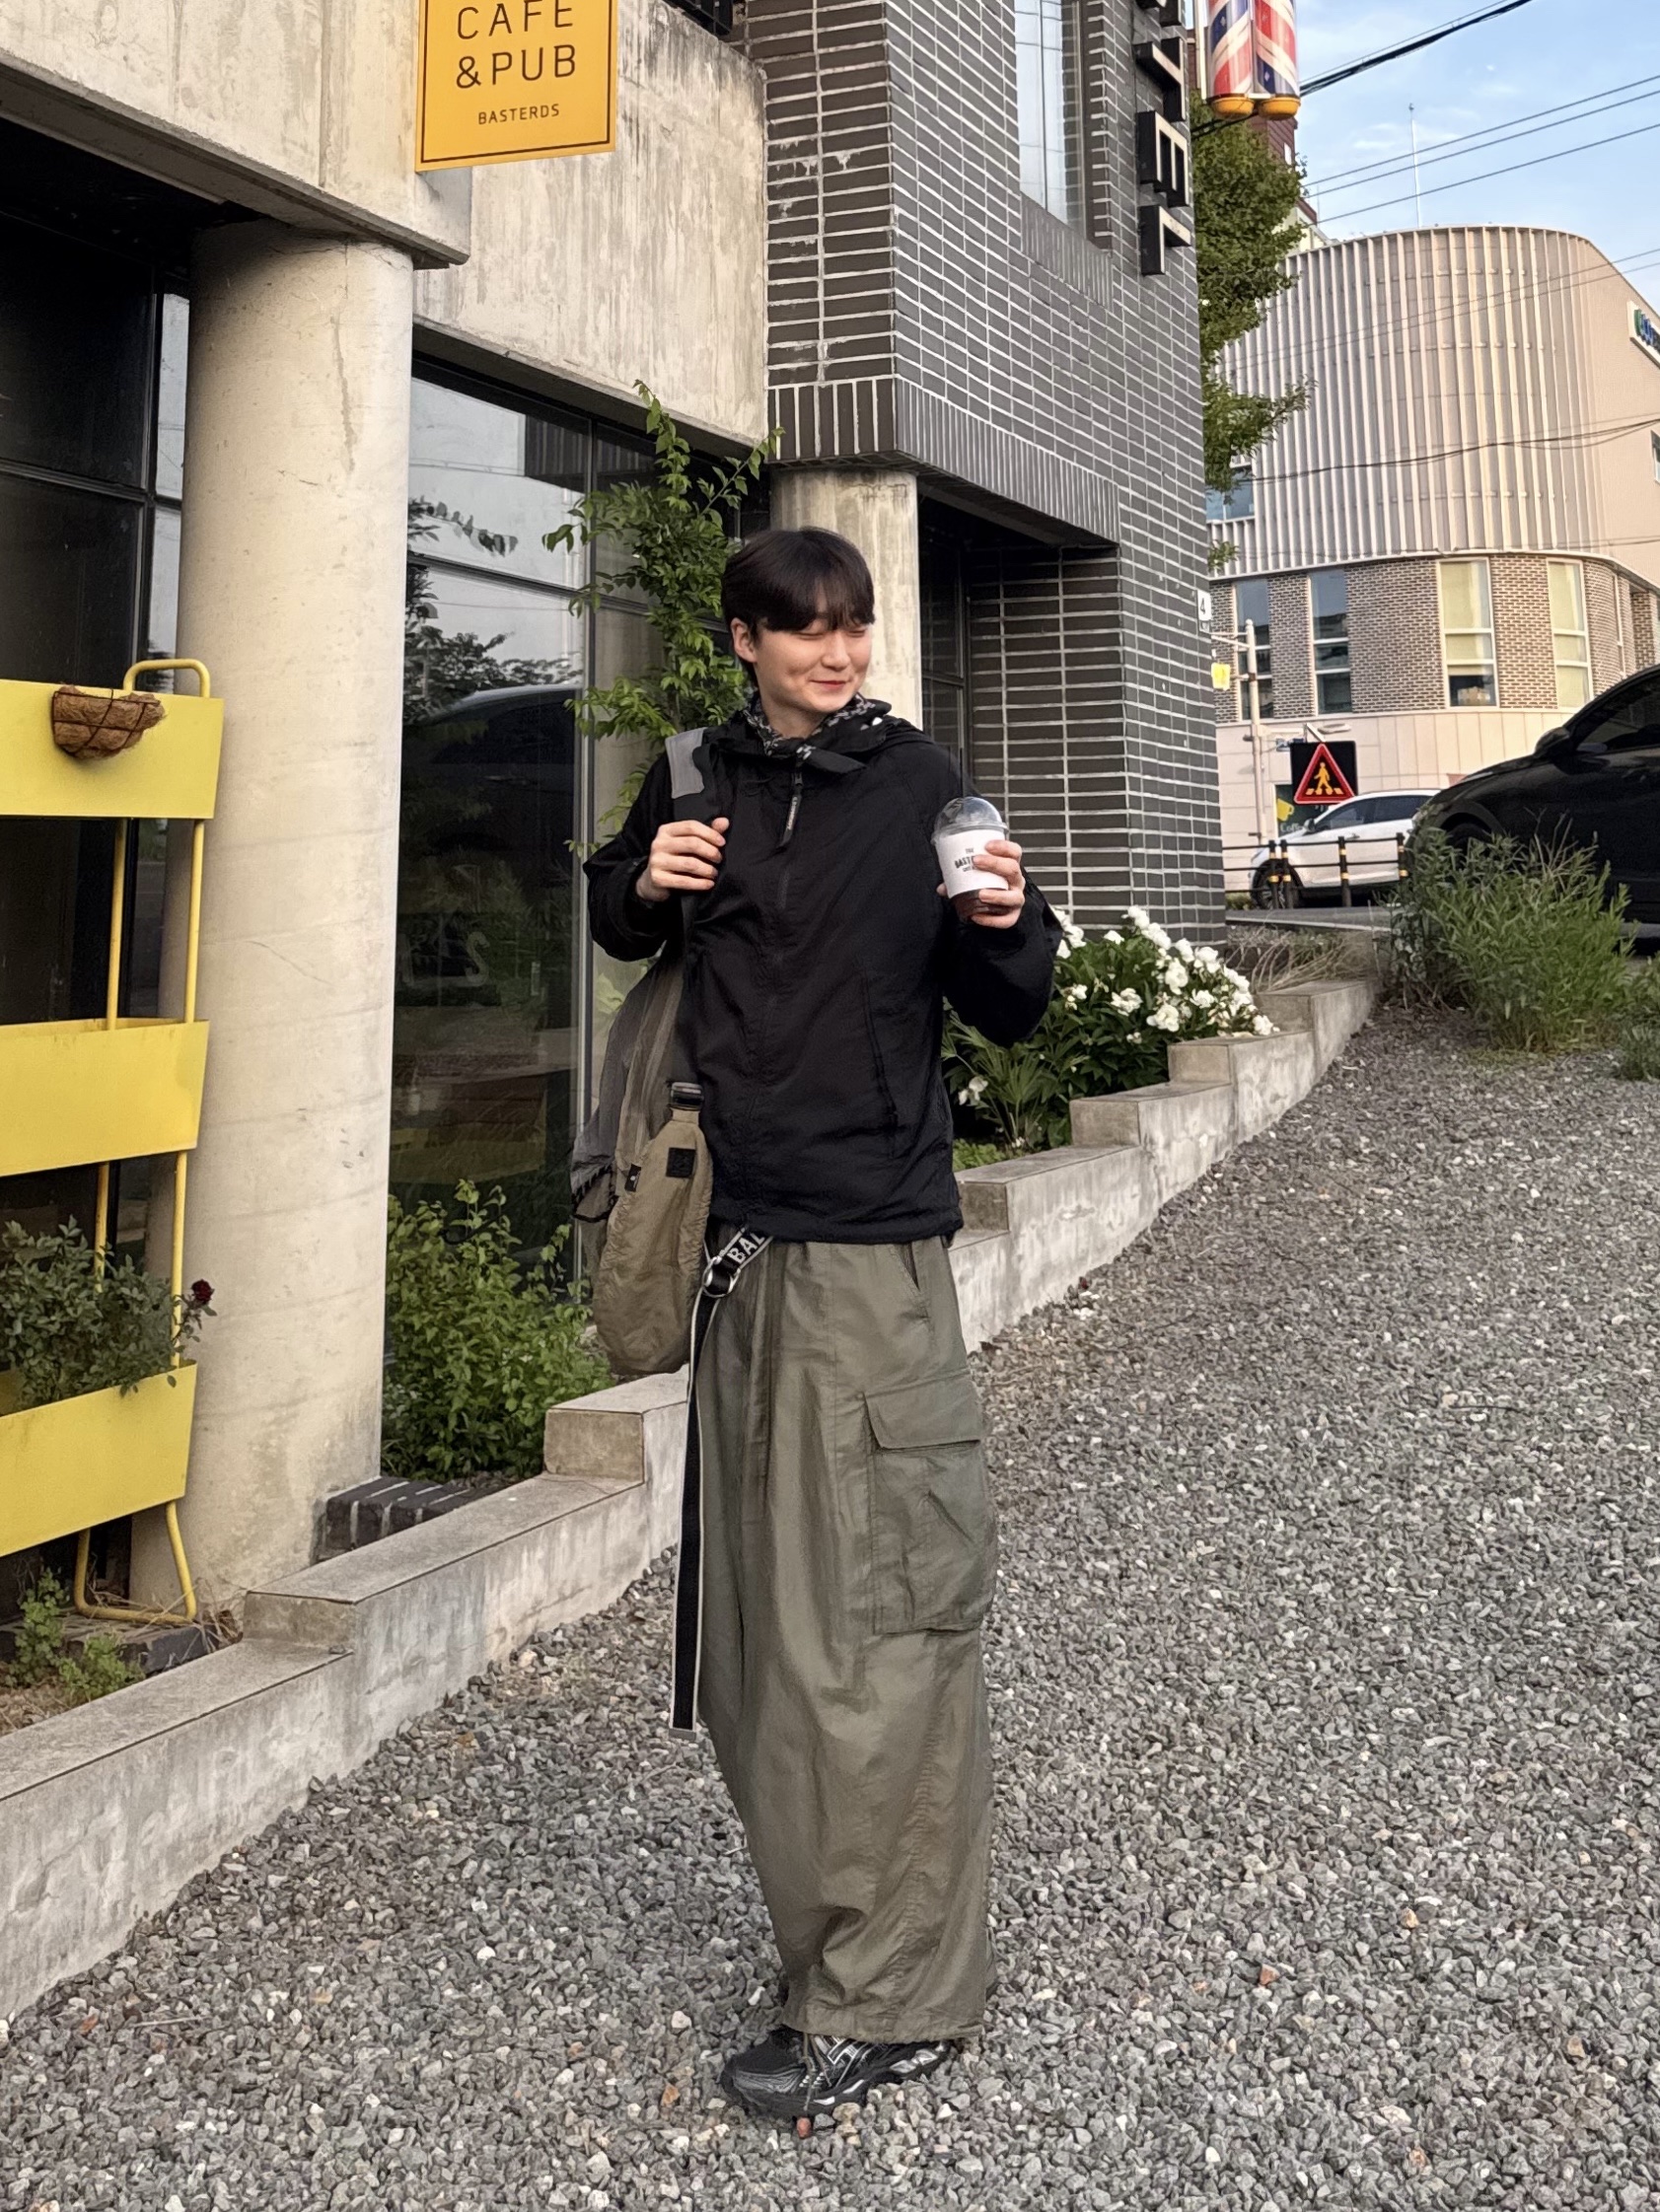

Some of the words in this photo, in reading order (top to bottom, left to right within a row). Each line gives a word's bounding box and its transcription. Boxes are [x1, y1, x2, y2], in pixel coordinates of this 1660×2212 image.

[457, 0, 573, 39] CAFE
[456, 44, 576, 89] &PUB
[477, 104, 560, 125] BASTERDS
